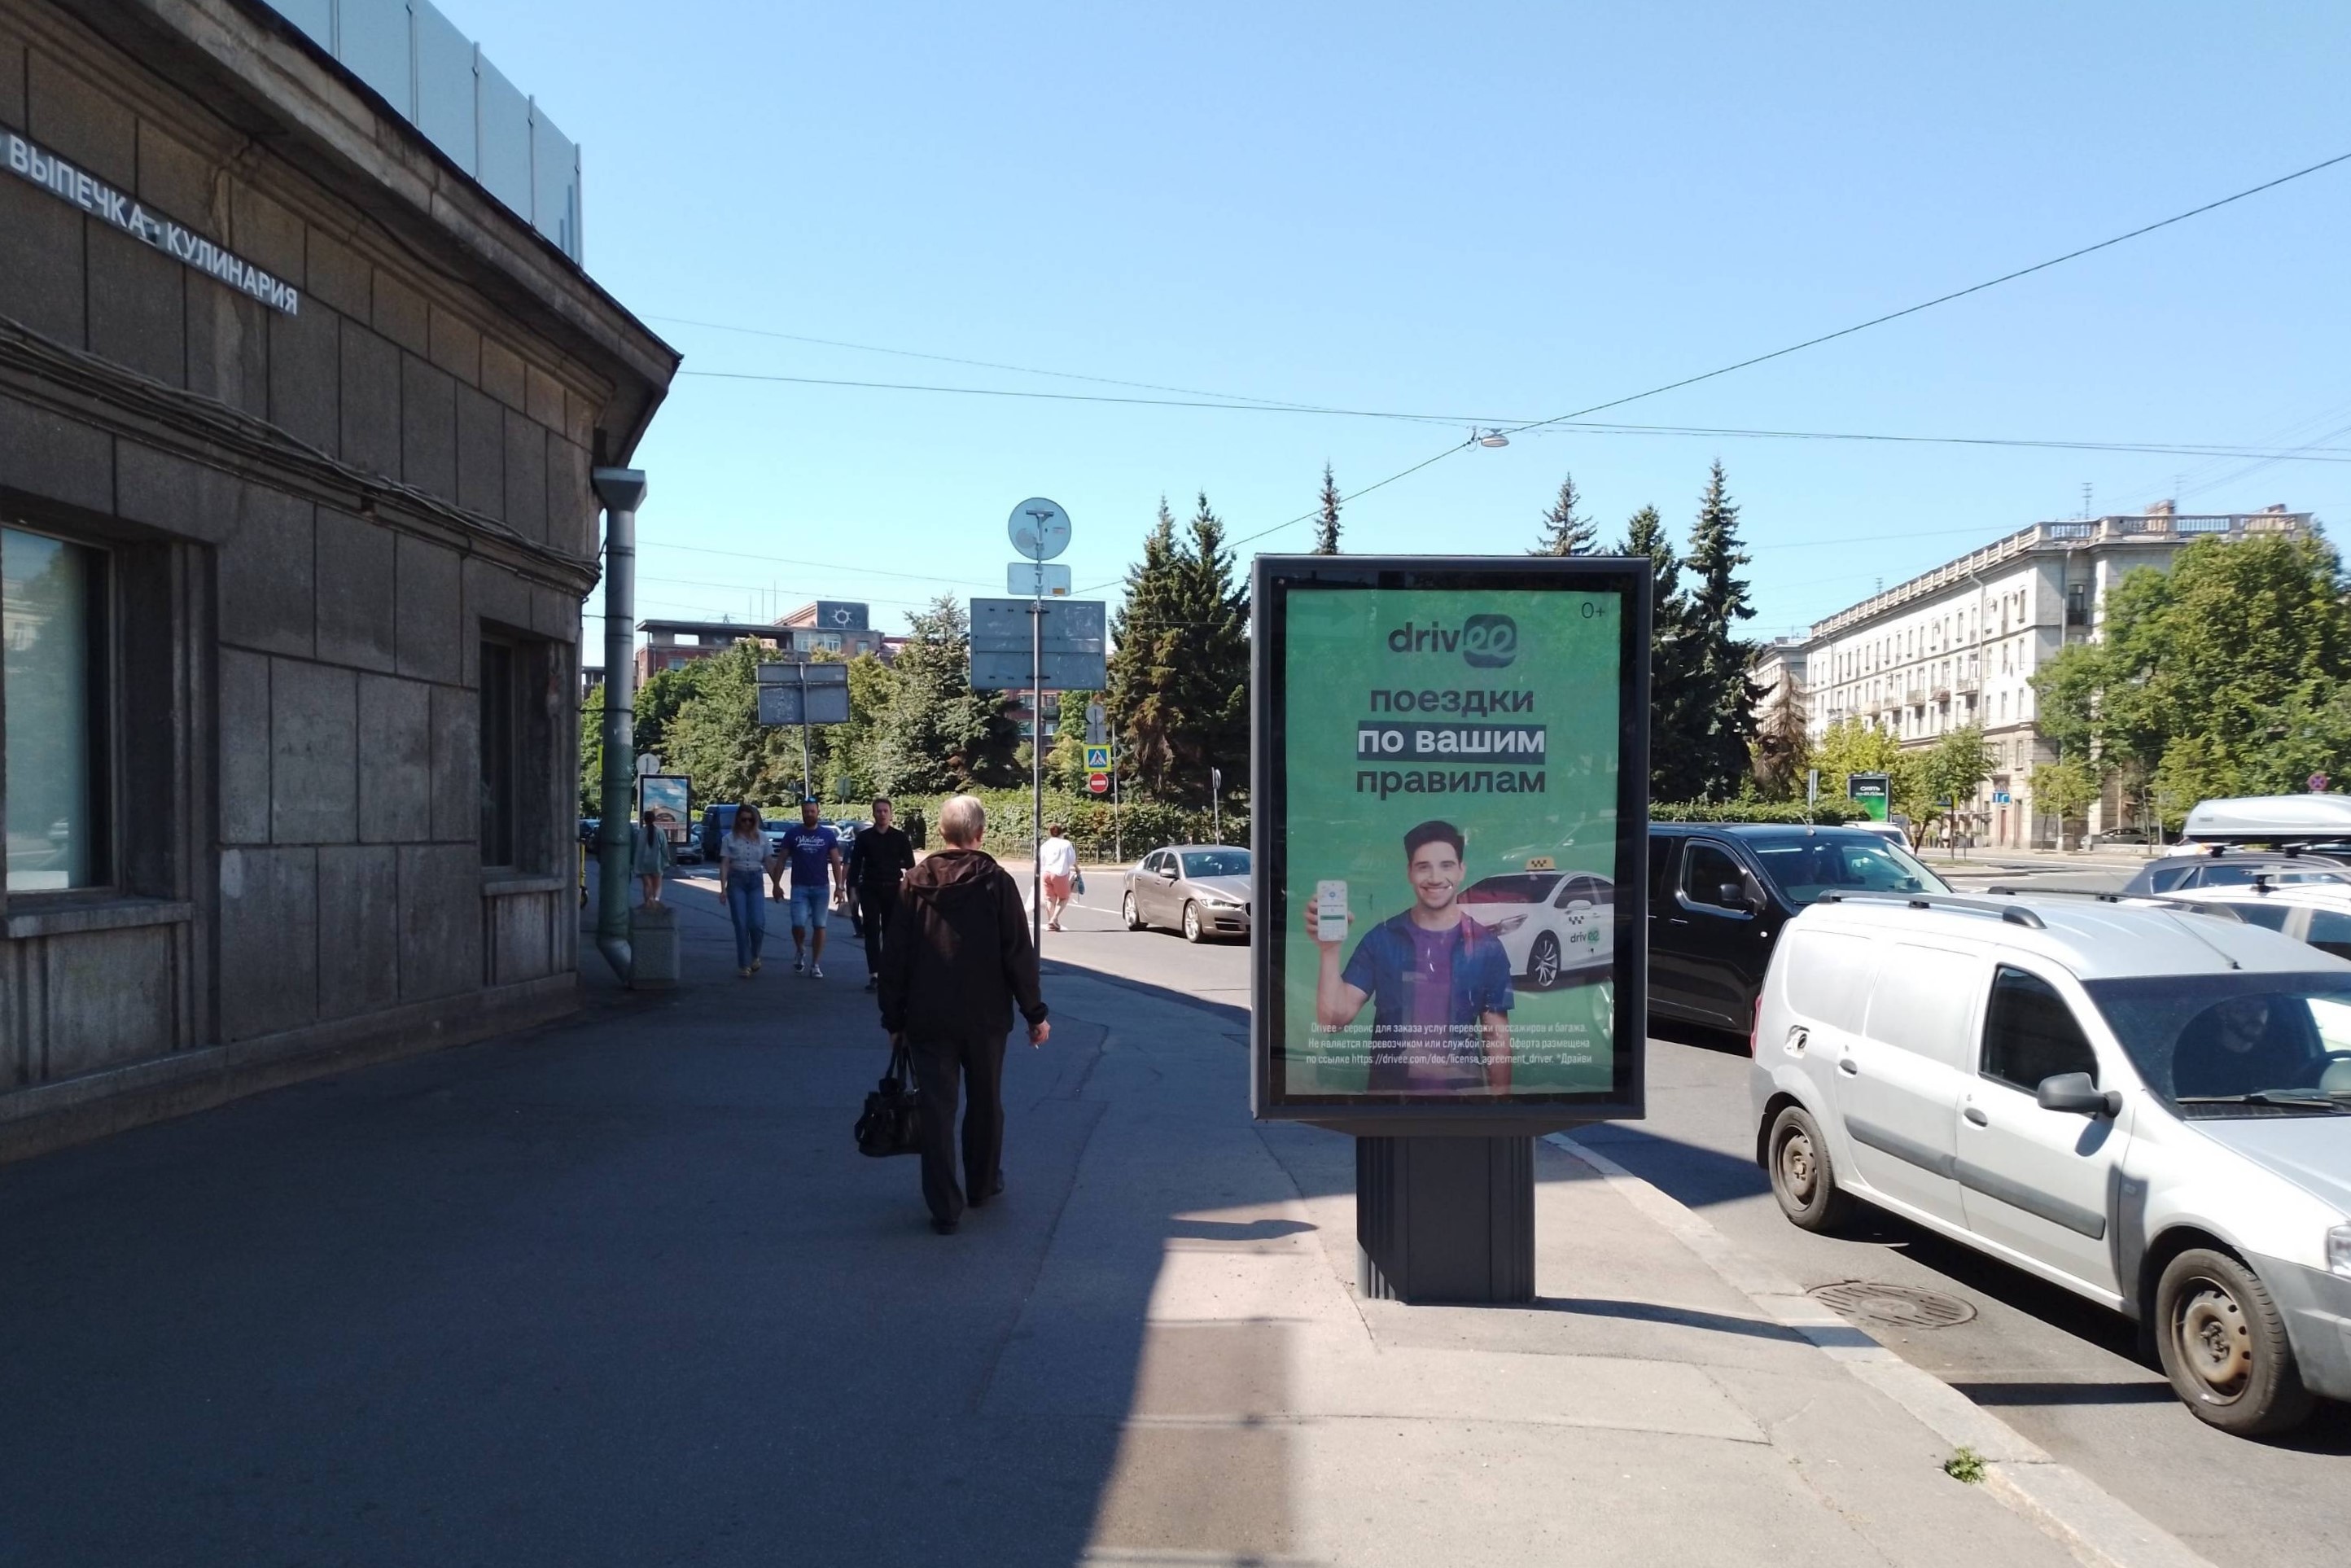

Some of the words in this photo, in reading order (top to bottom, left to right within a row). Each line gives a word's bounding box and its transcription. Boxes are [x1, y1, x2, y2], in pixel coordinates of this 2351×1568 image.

[9, 134, 147, 239] ВЫПЕЧКА
[167, 221, 298, 315] КУЛИНАРИЯ
[1581, 602, 1605, 619] 0+
[1388, 620, 1517, 659] drivee
[1371, 690, 1533, 717] поездки
[1358, 729, 1404, 753] по
[1416, 729, 1545, 753] вашим
[1356, 770, 1545, 800] правилам
[1570, 929, 1600, 944] drivee
[1311, 1023, 1337, 1032] Drivee
[1344, 1025, 1373, 1034] сервис
[1375, 1025, 1391, 1033] для
[1394, 1025, 1422, 1033] заказа
[1424, 1025, 1447, 1034] услуг
[1449, 1025, 1493, 1034] перевозки
[1308, 1038, 1319, 1048] Не
[1320, 1040, 1360, 1049] является
[1363, 1040, 1422, 1049] перевозчиком
[1425, 1040, 1440, 1048] или
[1443, 1038, 1479, 1050] службой
[1509, 1038, 1540, 1049] Оферта
[1542, 1040, 1590, 1049] размещена
[1307, 1055, 1316, 1063] по
[1319, 1055, 1350, 1063] ссылке
